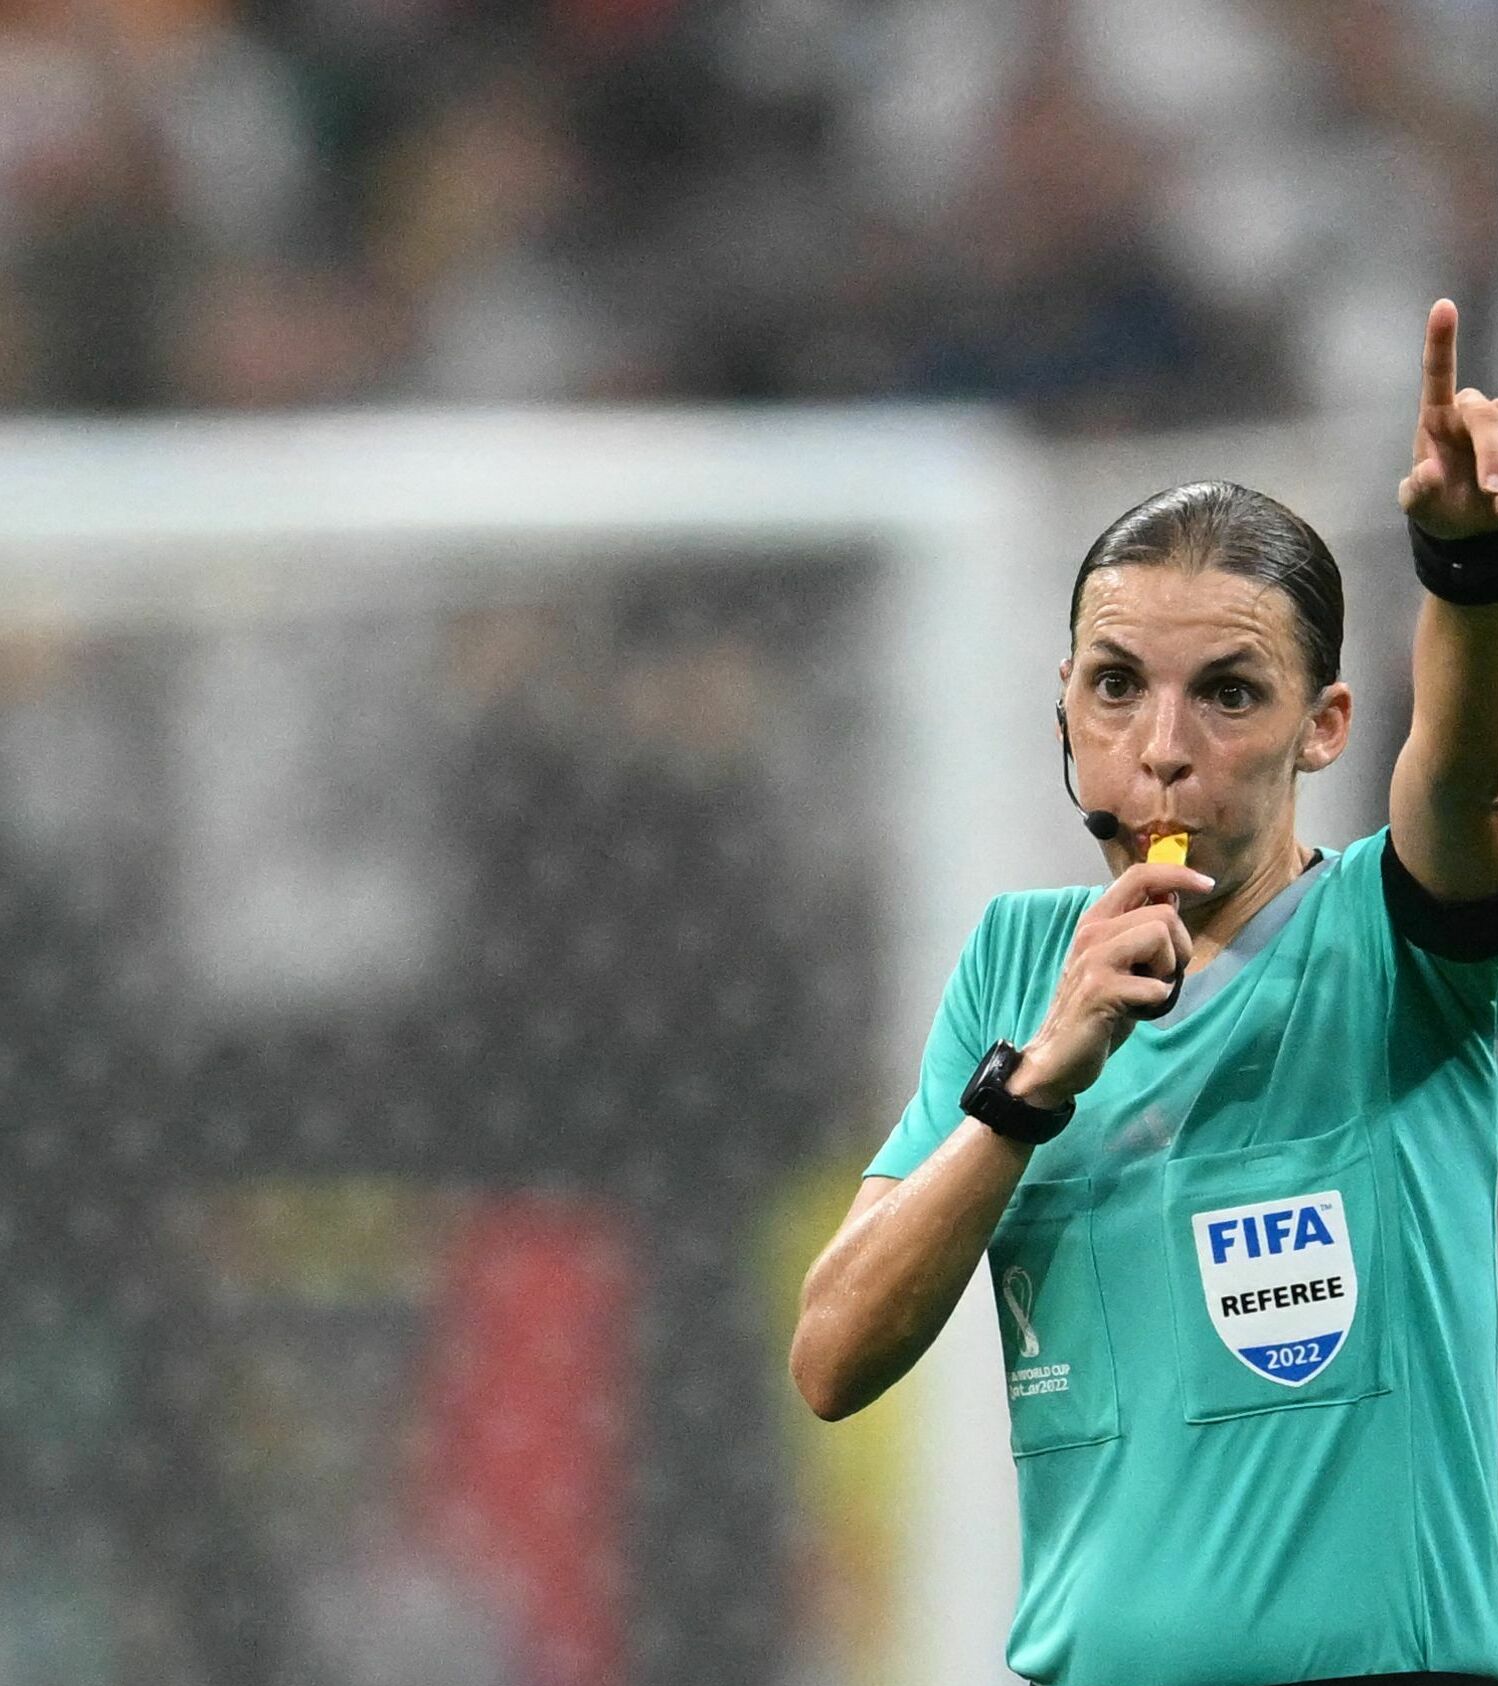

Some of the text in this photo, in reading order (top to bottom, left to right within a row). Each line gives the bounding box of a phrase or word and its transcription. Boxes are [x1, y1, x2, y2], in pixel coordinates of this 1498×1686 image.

[1207, 1206, 1335, 1265] FIFA
[1220, 1276, 1345, 1318] REFEREE
[1051, 1363, 1071, 1377] CUP
[1265, 1342, 1322, 1370] 2022
